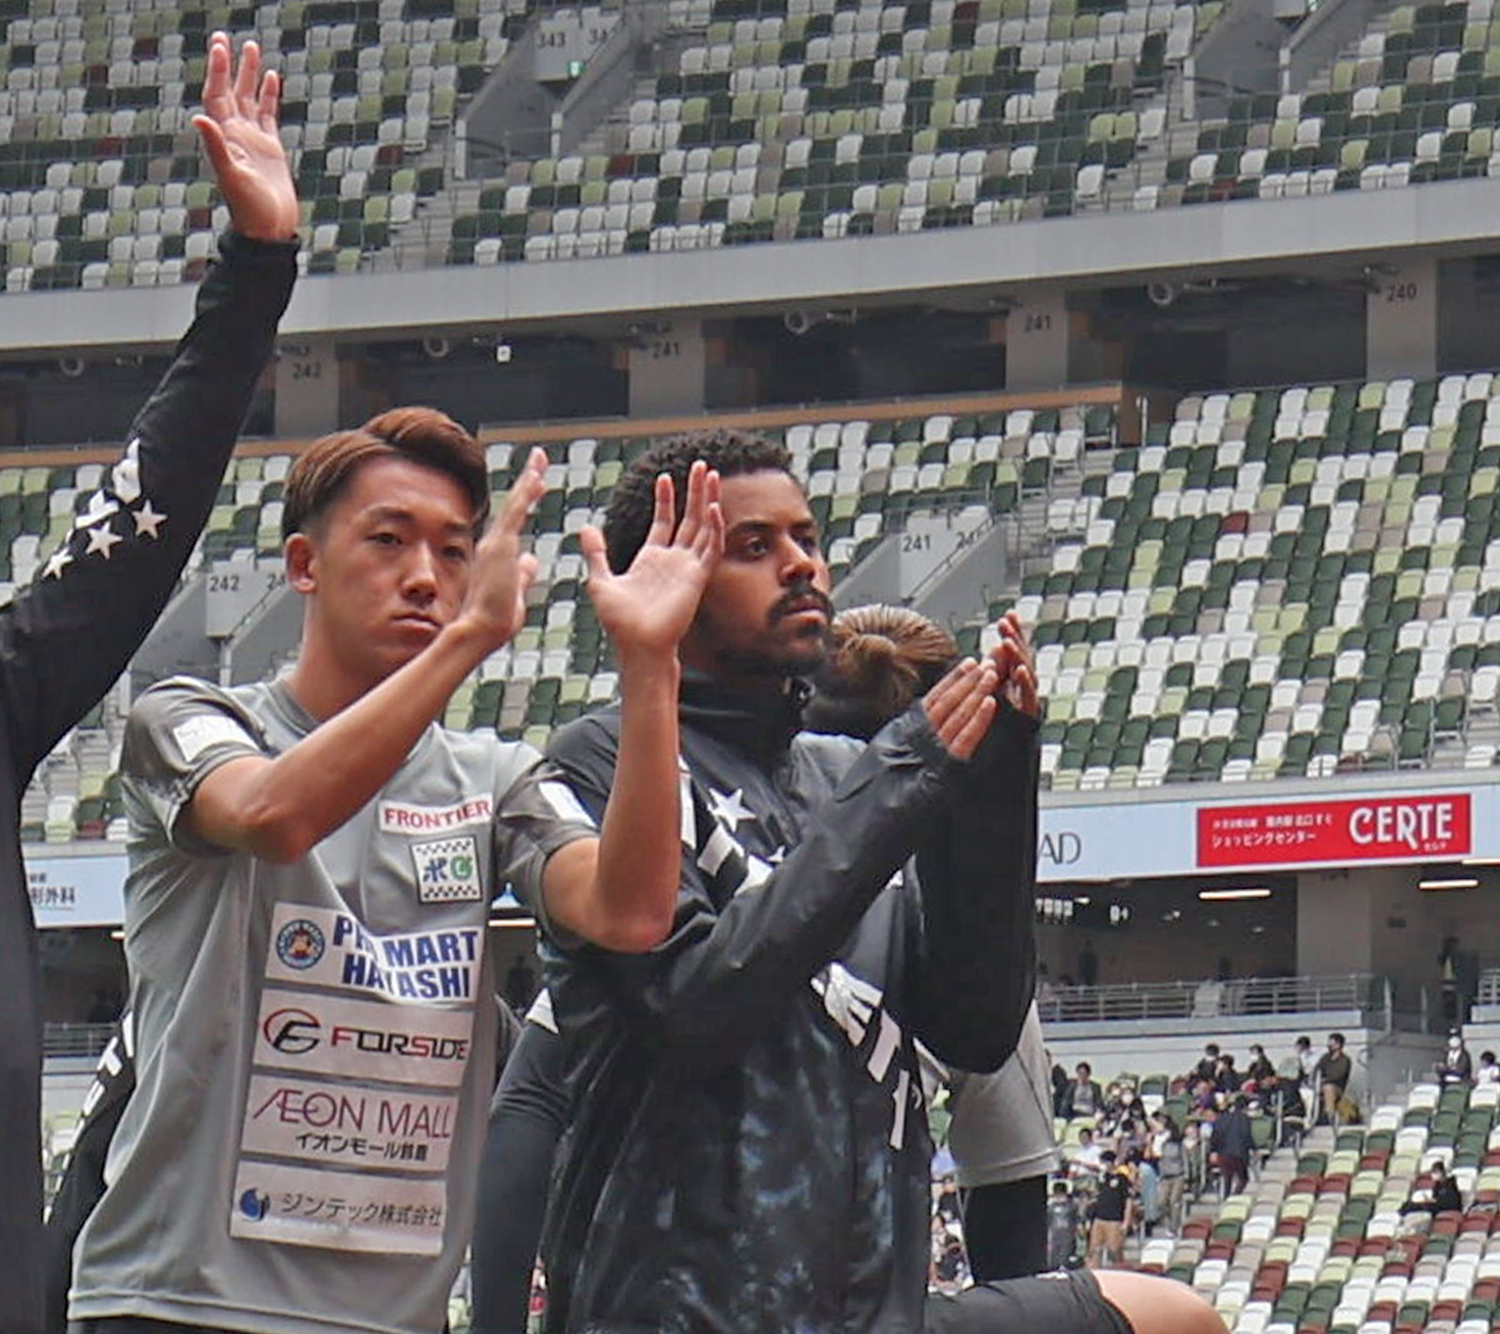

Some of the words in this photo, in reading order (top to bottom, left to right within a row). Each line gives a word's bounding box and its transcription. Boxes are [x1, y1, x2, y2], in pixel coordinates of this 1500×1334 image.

[903, 533, 930, 552] 241
[209, 575, 240, 593] 242
[384, 800, 490, 828] FRONTIER
[1349, 803, 1453, 850] CERTE
[383, 930, 479, 967] MART
[331, 1026, 469, 1060] FORSIDE
[378, 1099, 450, 1138] MALL
